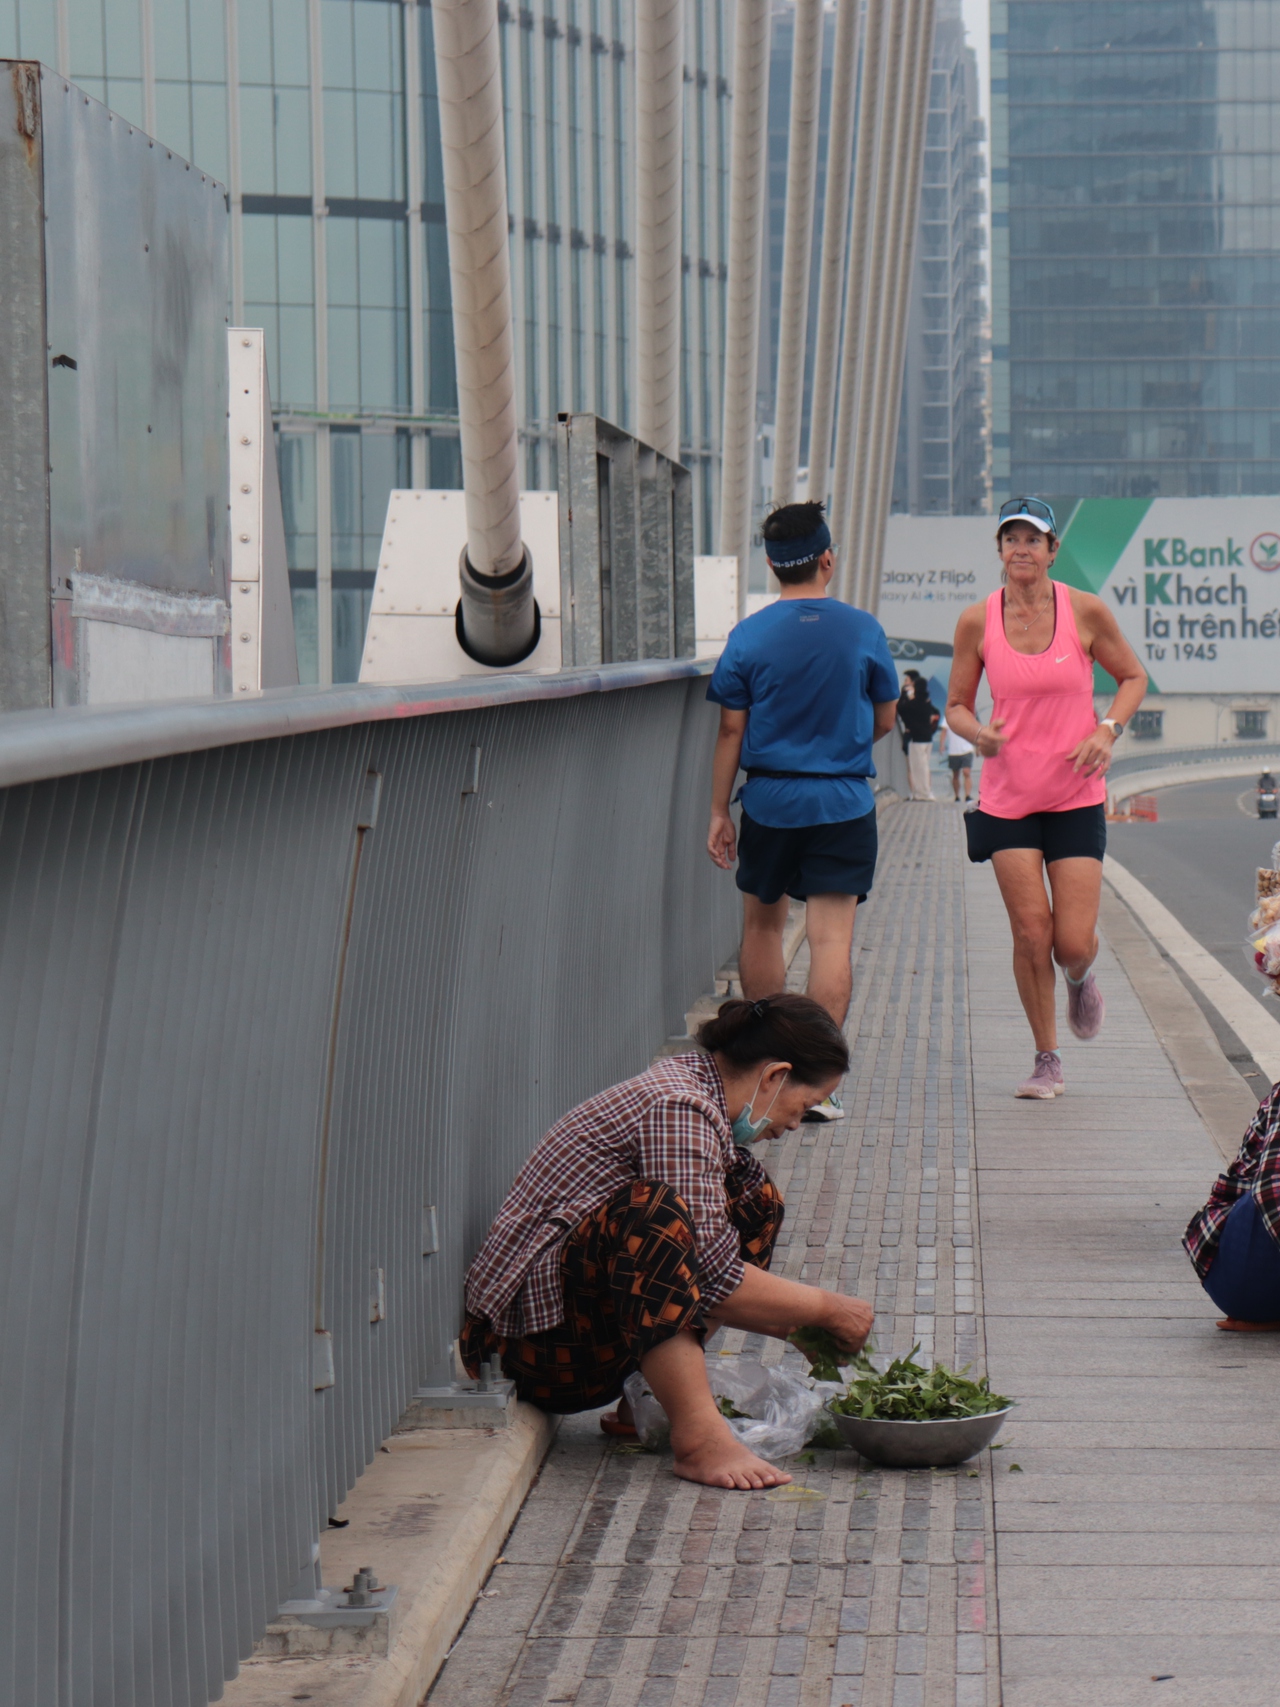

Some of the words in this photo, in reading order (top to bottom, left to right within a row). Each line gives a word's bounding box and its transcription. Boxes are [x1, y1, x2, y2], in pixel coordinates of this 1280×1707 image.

[1144, 538, 1244, 568] KBank
[882, 570, 925, 586] alaxy
[927, 570, 937, 584] Z
[940, 569, 976, 588] Flip6
[1112, 578, 1138, 605] vì
[1145, 573, 1248, 606] Khách
[937, 591, 946, 601] is
[948, 591, 977, 601] here
[1145, 608, 1170, 639] là
[1179, 613, 1237, 639] trên
[1145, 643, 1166, 661] Từ
[1174, 644, 1218, 661] 1945
